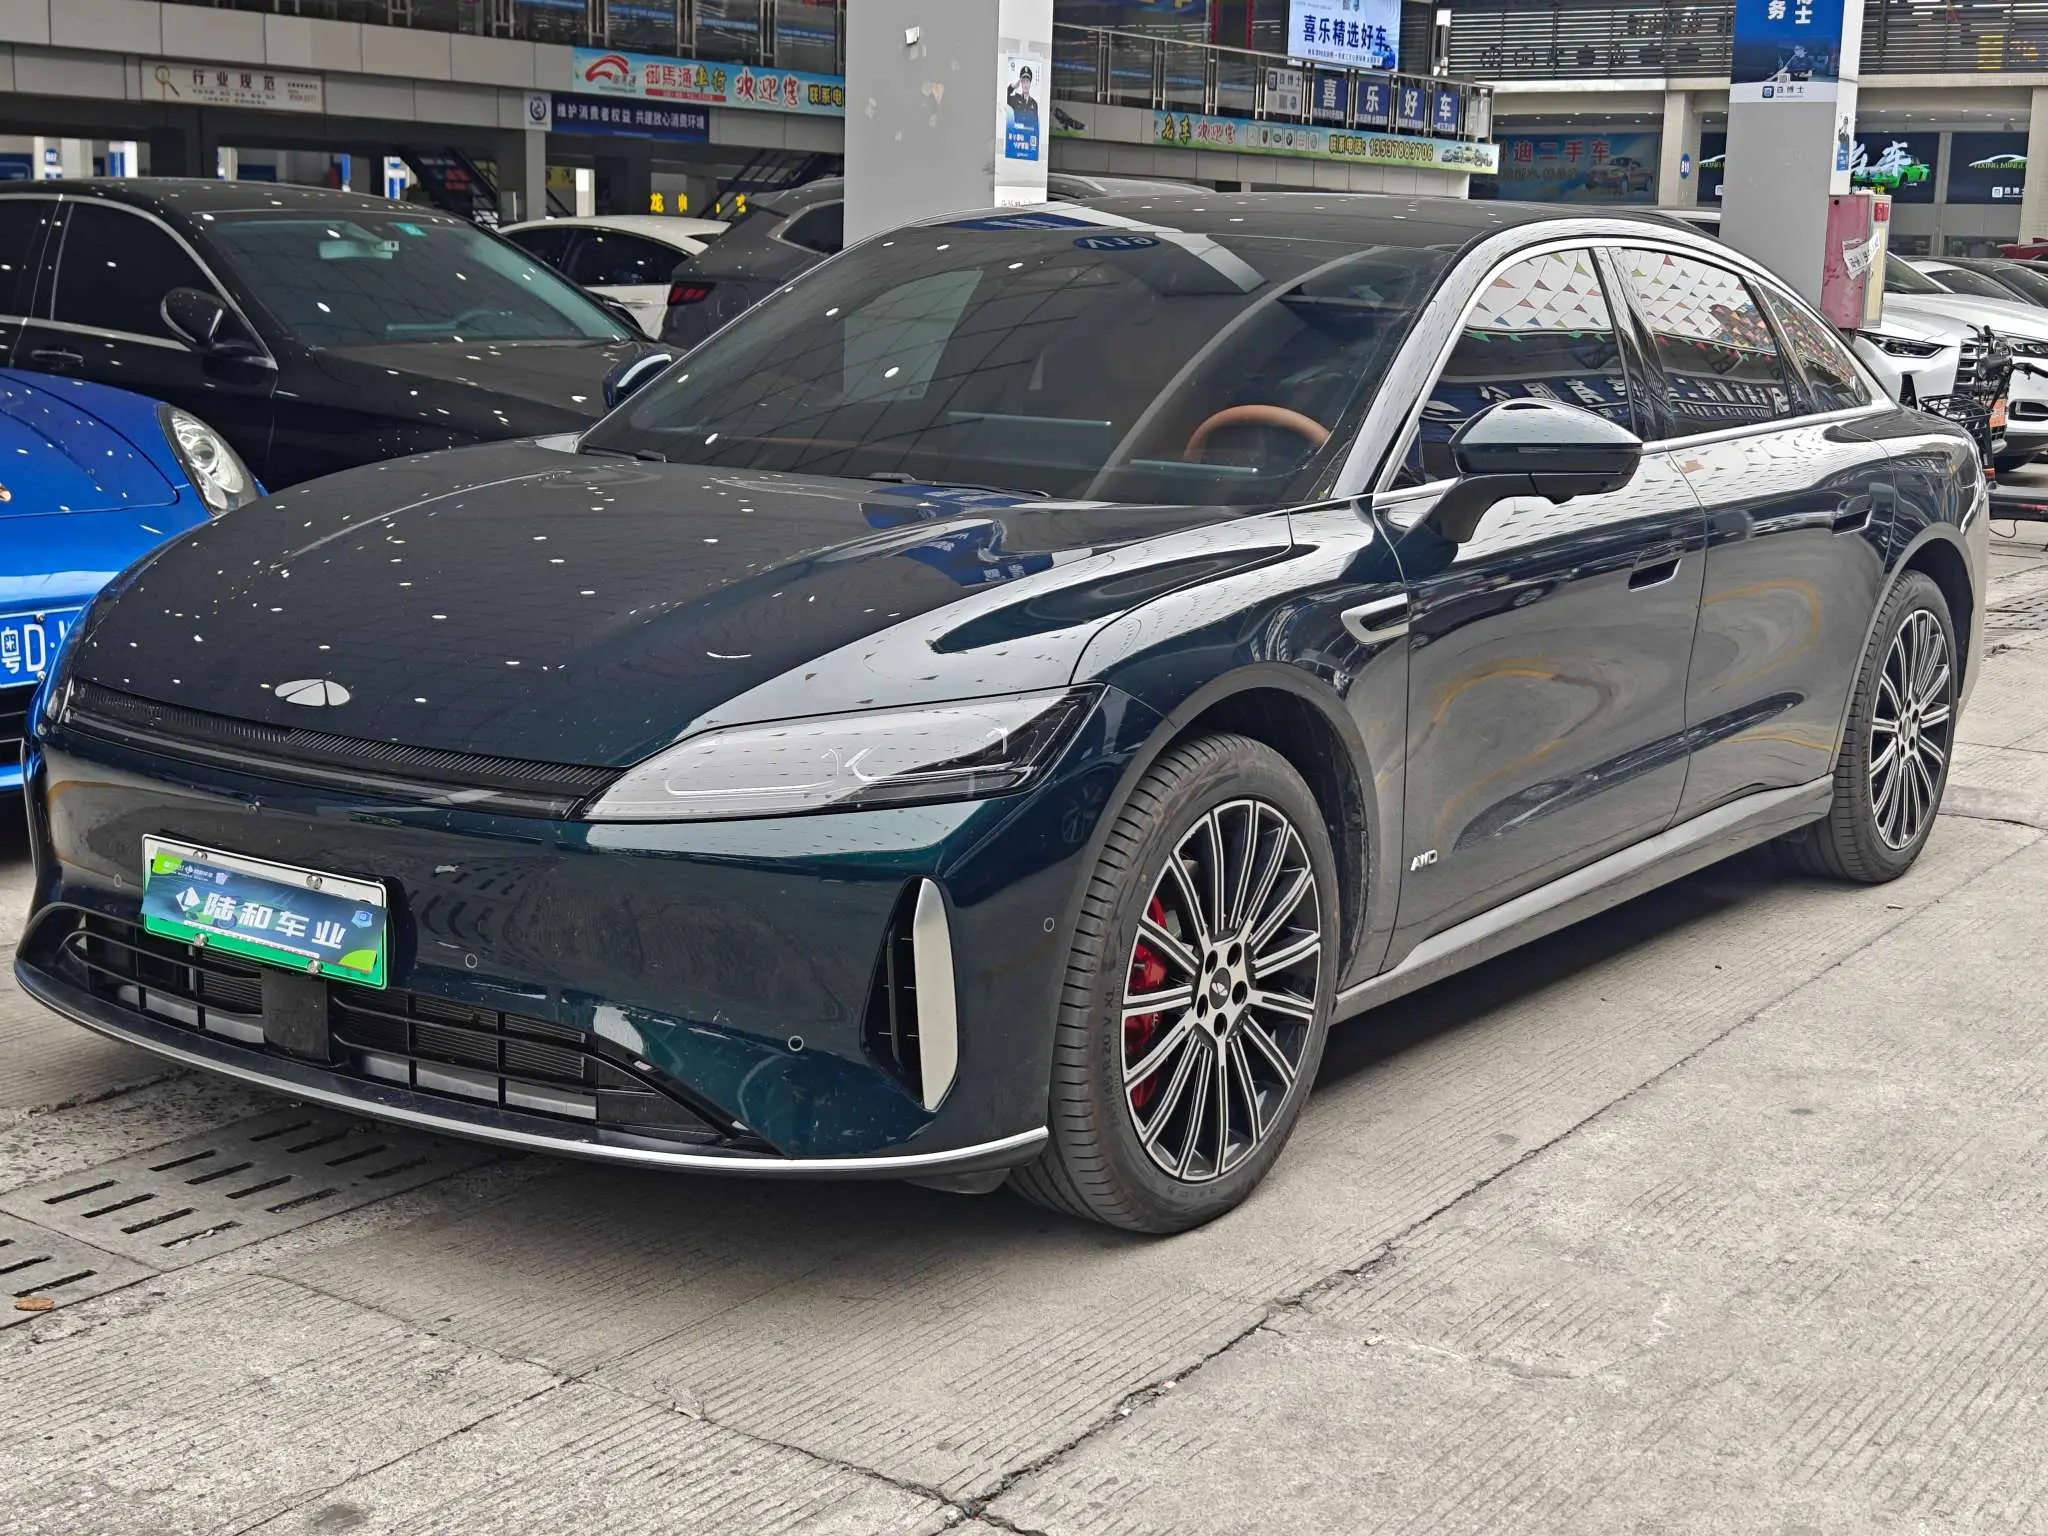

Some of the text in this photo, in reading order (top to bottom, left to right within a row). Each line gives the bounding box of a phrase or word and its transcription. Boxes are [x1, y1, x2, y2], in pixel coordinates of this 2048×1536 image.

[1303, 14, 1388, 51] 喜乐精选好车
[193, 68, 275, 91] 行业规范
[202, 891, 347, 950] 陆和车业
